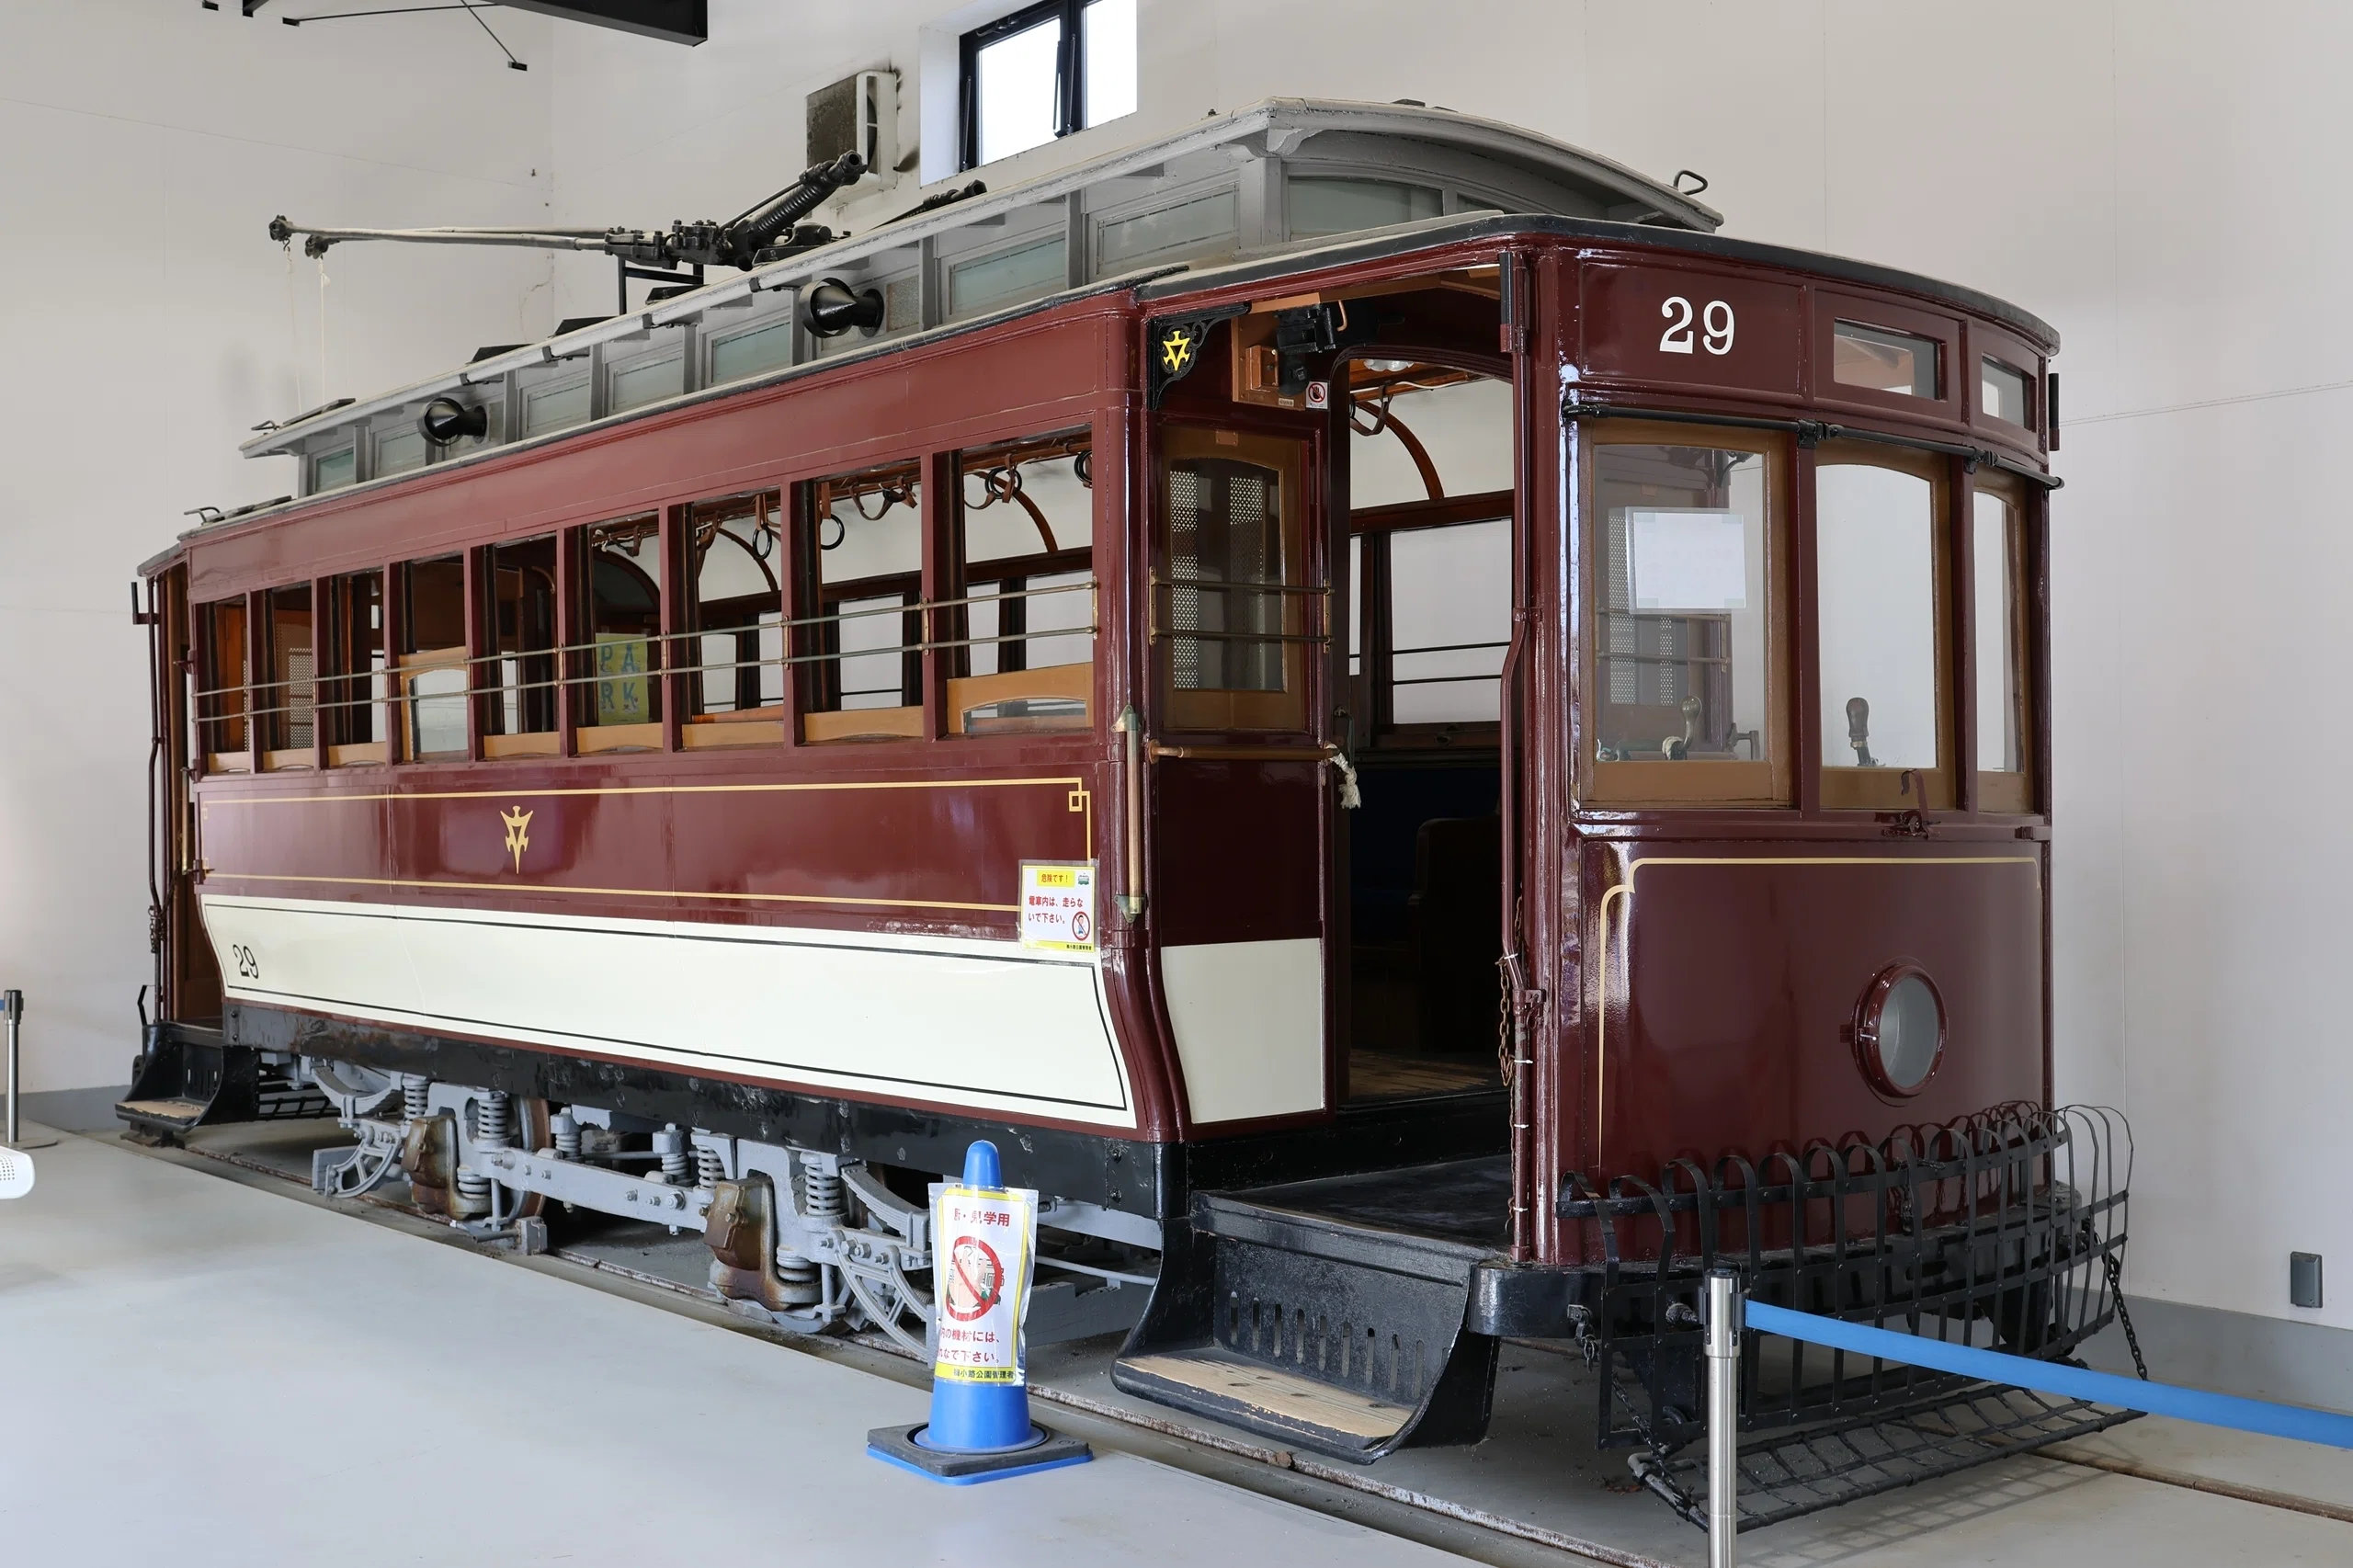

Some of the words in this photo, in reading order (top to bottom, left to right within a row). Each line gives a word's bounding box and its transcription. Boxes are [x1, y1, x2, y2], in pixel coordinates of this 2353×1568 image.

[1659, 296, 1735, 356] 29
[1029, 895, 1084, 908] 電車内は、走らな
[1028, 913, 1065, 924] いで下さい。
[233, 944, 259, 980] 29
